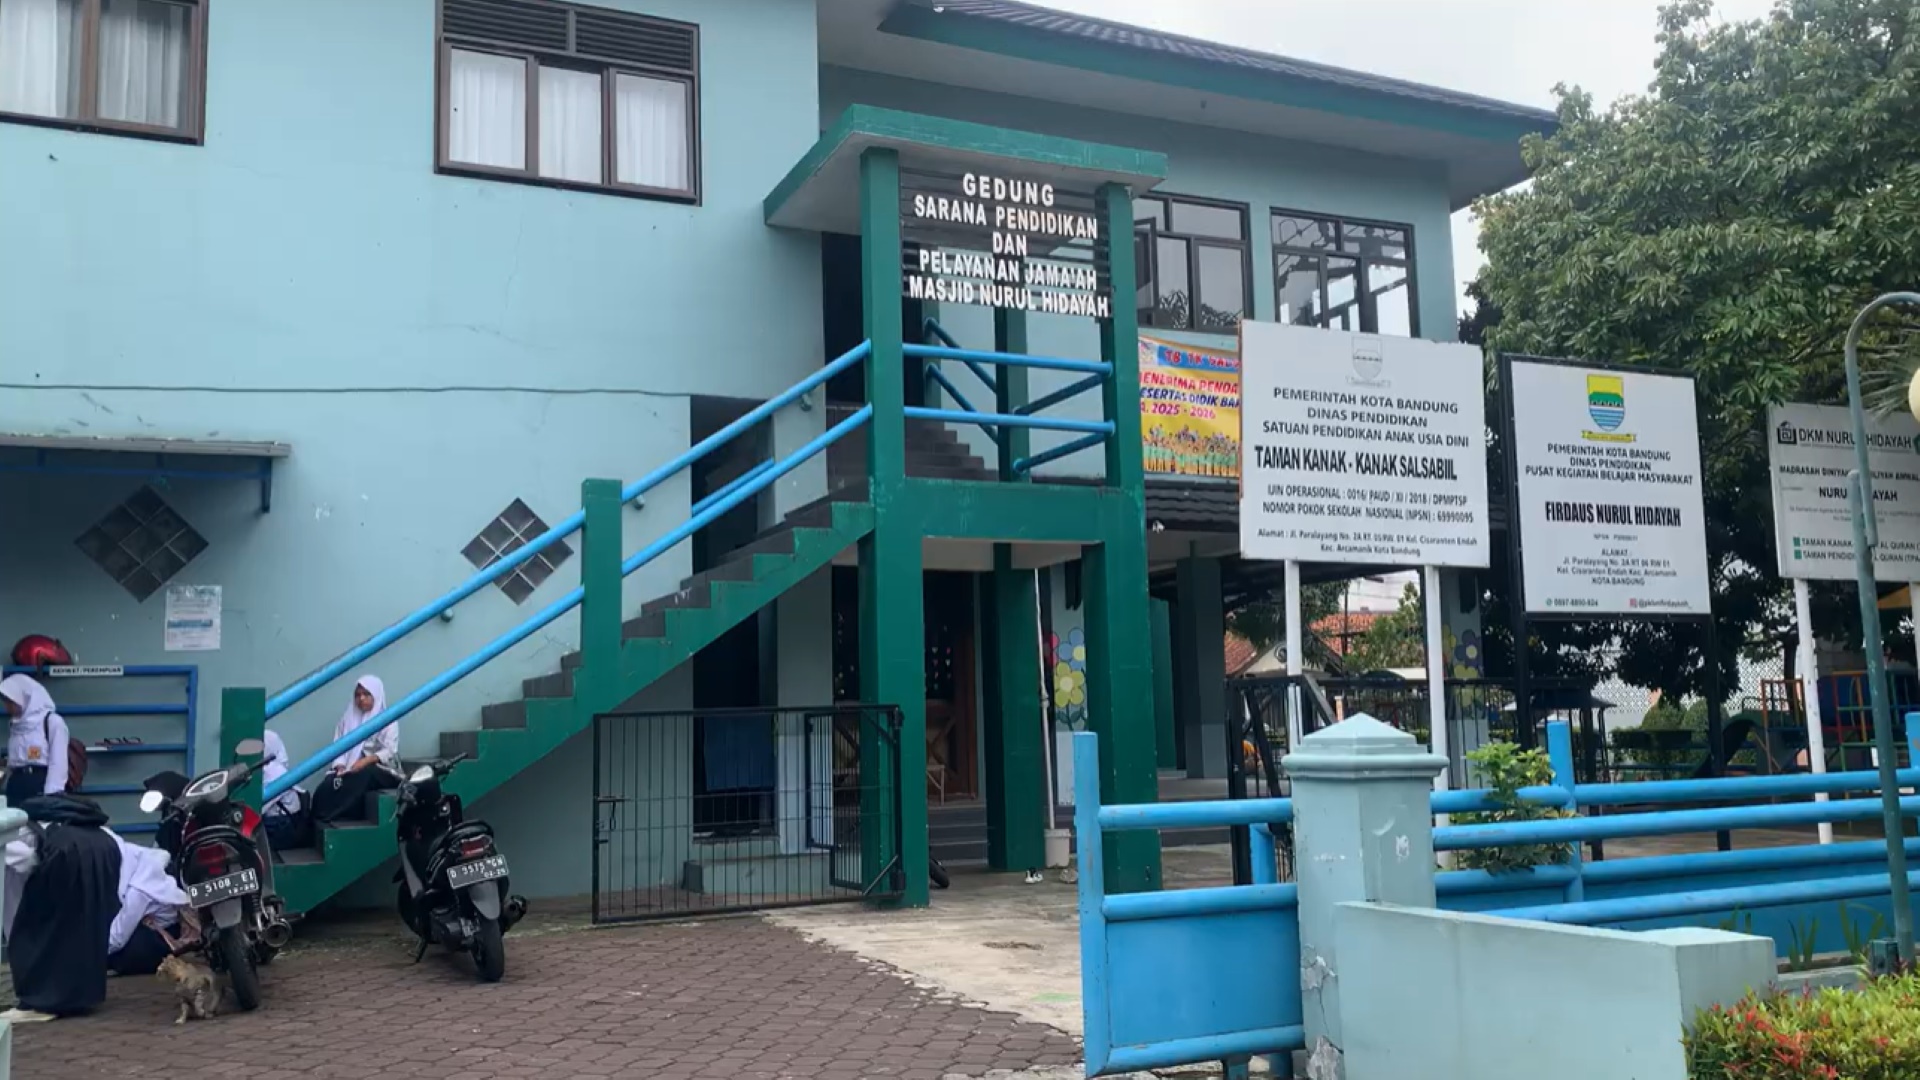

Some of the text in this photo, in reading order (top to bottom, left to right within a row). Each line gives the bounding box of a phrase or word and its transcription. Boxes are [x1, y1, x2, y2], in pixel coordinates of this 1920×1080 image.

[963, 172, 1054, 206] GEDUNG
[914, 194, 1098, 239] SARANA PENDIDIKAN
[992, 232, 1027, 256] DAN
[920, 250, 1097, 291] PELAYANAN JAMA'AH
[909, 275, 1110, 318] MASJID NURUL HIDAYAH
[1138, 372, 1196, 390] ENERIMA
[1189, 394, 1218, 406] DIDIK
[1274, 387, 1458, 414] PEMERINTAH KOTA BANDUNG
[1152, 402, 1181, 415] 2025
[1190, 406, 1216, 420] 2026
[1308, 406, 1428, 428] DINAS PENDIDIKAN
[1263, 420, 1470, 448] SATUAN PENDIDIKAN ANAK USIA DINI
[1799, 428, 1824, 442] DKM
[1826, 430, 1857, 446] NURU
[1866, 433, 1912, 449] HIDAYAH
[1547, 442, 1671, 462] PEMERINTAH KOTA BANDUNG
[1254, 445, 1300, 471] TAMAN
[1303, 447, 1348, 474] KANAK
[1356, 451, 1398, 477] KANAK
[1400, 455, 1458, 481] SALSABIIL
[1570, 456, 1652, 471] DINAS PENDIDIKAN
[1780, 464, 1821, 475] MADRASAH
[1525, 464, 1693, 486] PUSAT KEGIATAN BELAJAR MASYARAKAT
[1285, 484, 1341, 499] OPERASIONAL
[1369, 490, 1390, 502] PAUD
[1408, 492, 1428, 505] 2018
[1819, 486, 1848, 499] NURU
[1262, 501, 1296, 514] NOMOR
[1298, 502, 1326, 516] POKOK
[1327, 504, 1362, 518] SEKOLAH
[1366, 506, 1404, 520] NASIONAL
[1545, 501, 1682, 528] FIRDAUS NURUL HIDAYAH
[1258, 528, 1285, 538] Alamat
[1802, 538, 1826, 548] TAMAN
[1890, 540, 1916, 552] QURAN
[1802, 550, 1827, 560] TAMAN
[1880, 553, 1904, 563] QURAN
[1592, 577, 1645, 587] KOTA BANDUNG
[450, 869, 457, 879] D
[190, 886, 198, 897] D
